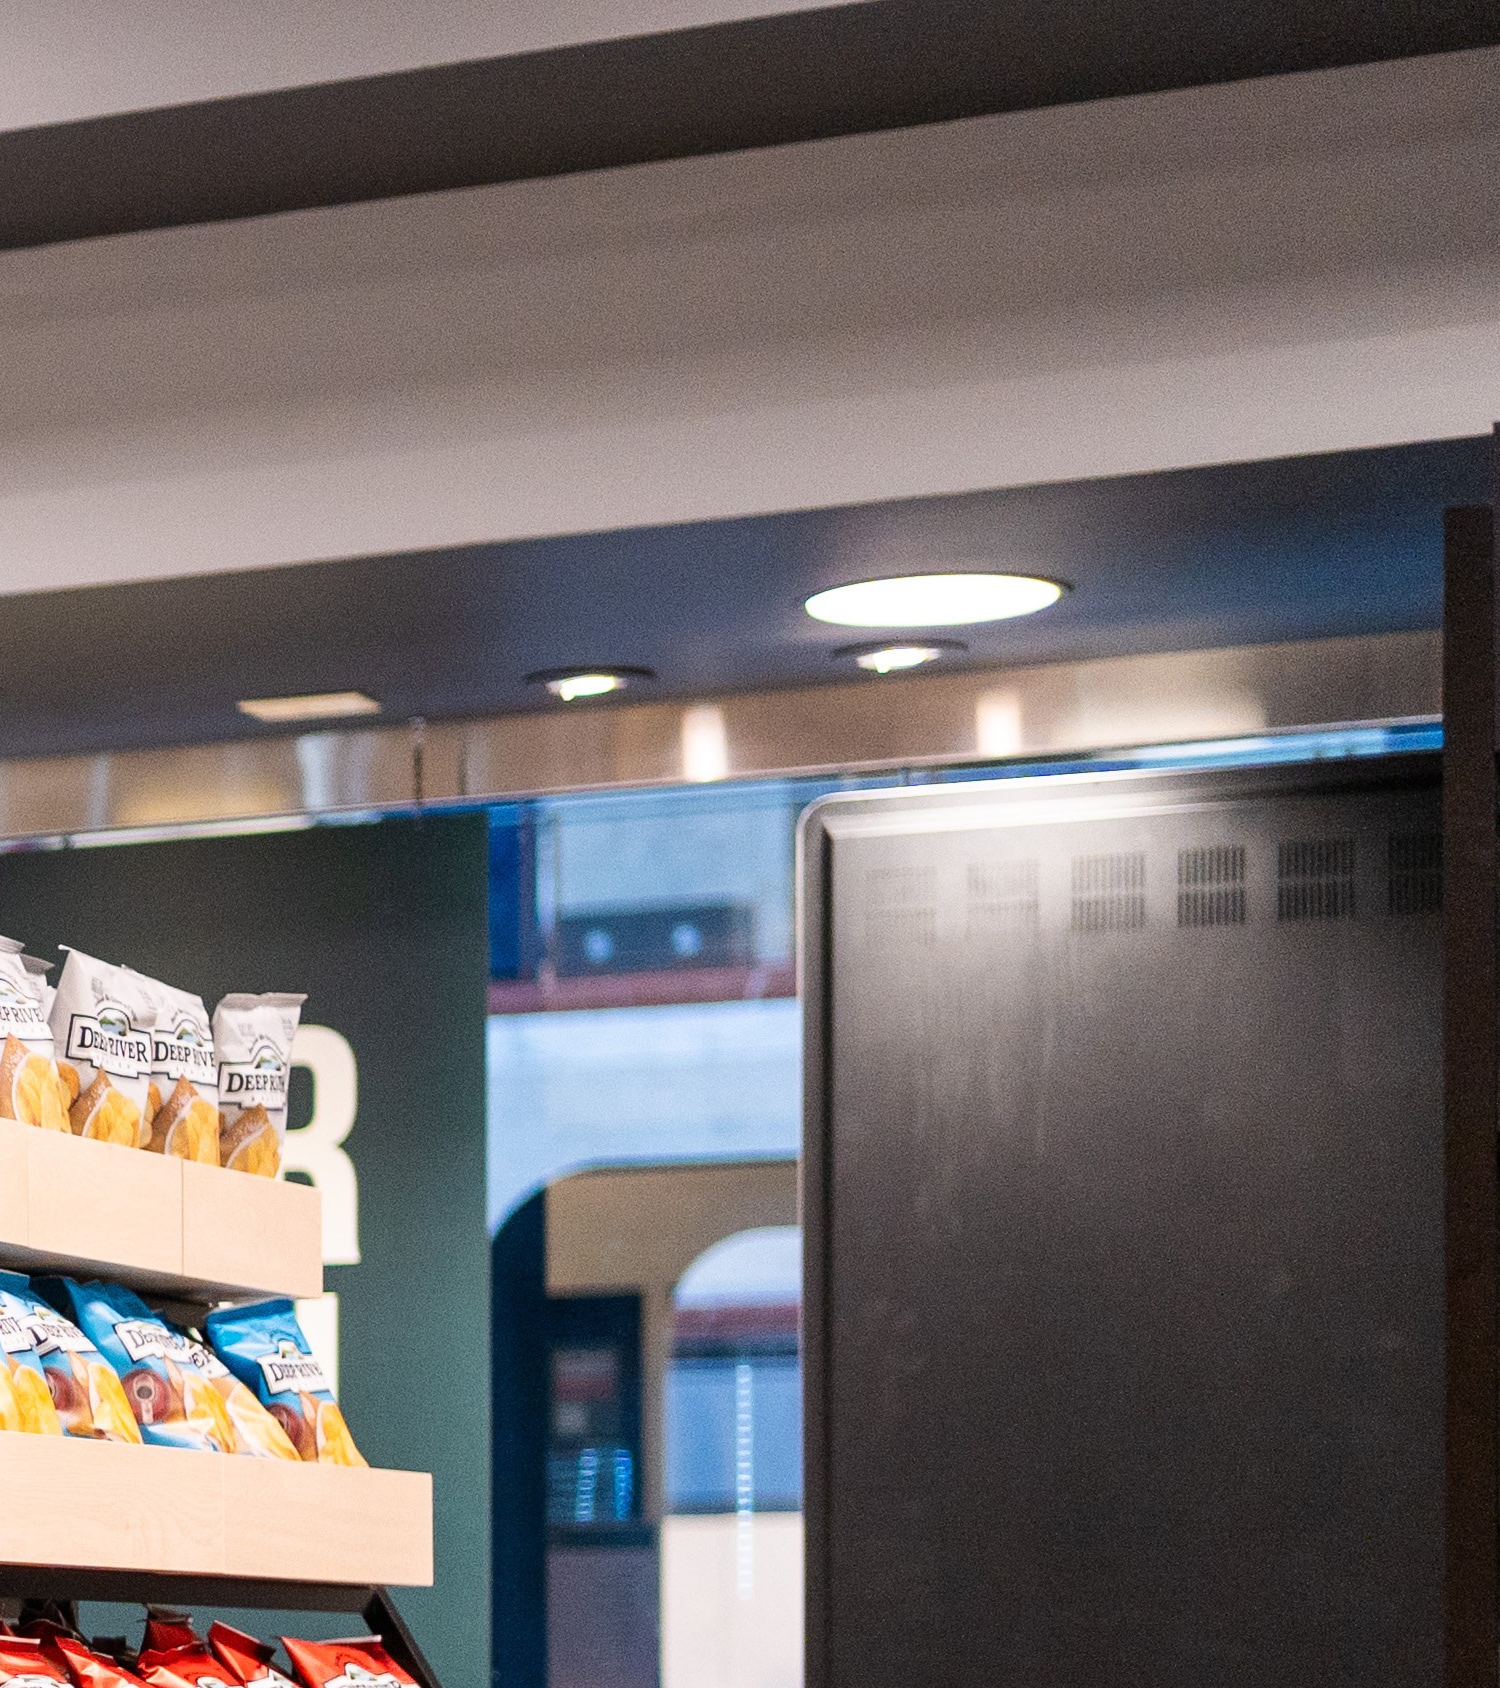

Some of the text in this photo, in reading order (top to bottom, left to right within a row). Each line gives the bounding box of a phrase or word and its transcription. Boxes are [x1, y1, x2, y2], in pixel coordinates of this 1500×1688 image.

[108, 1040, 149, 1064] RIVER
[154, 1041, 189, 1063] DEEP
[227, 1072, 268, 1093] DEEP
